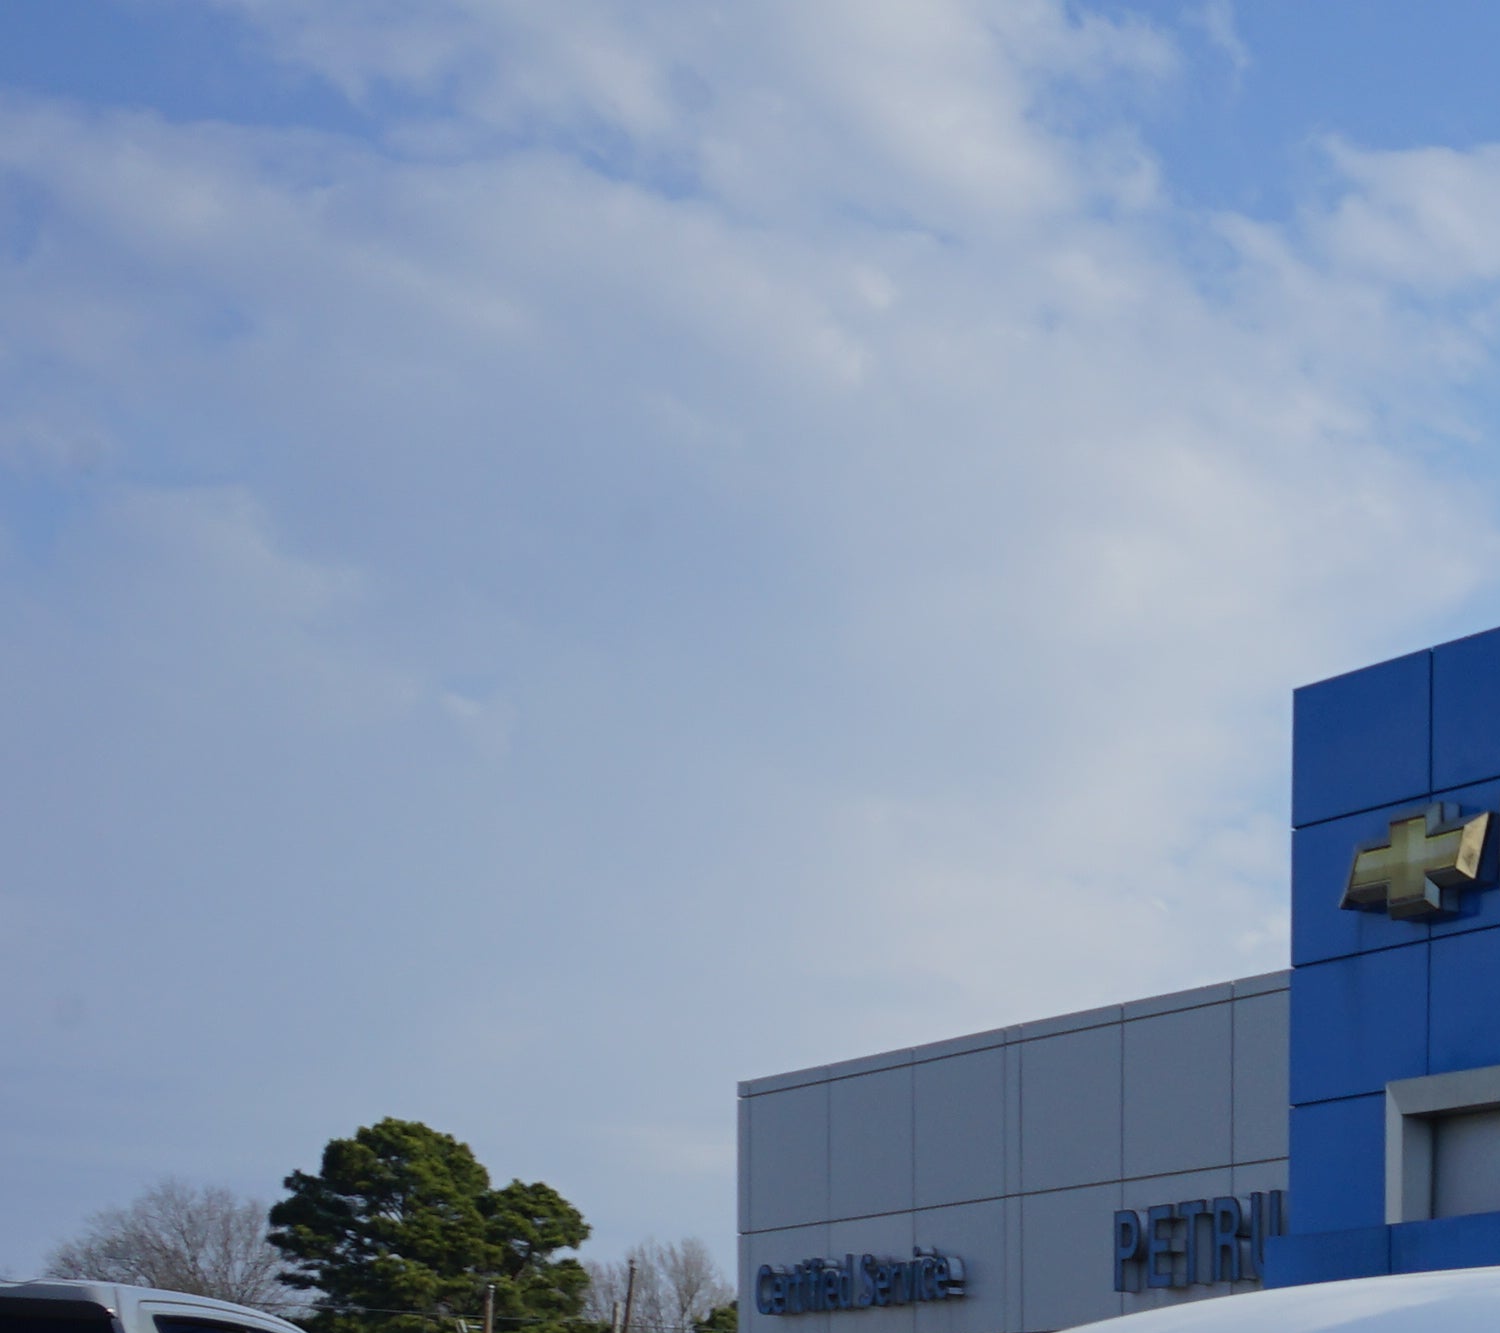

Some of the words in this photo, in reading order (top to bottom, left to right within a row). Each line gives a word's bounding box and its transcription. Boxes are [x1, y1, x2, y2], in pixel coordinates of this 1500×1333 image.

[756, 1254, 854, 1316] Certified
[857, 1246, 966, 1308] Service
[1114, 1190, 1284, 1292] PETRU
